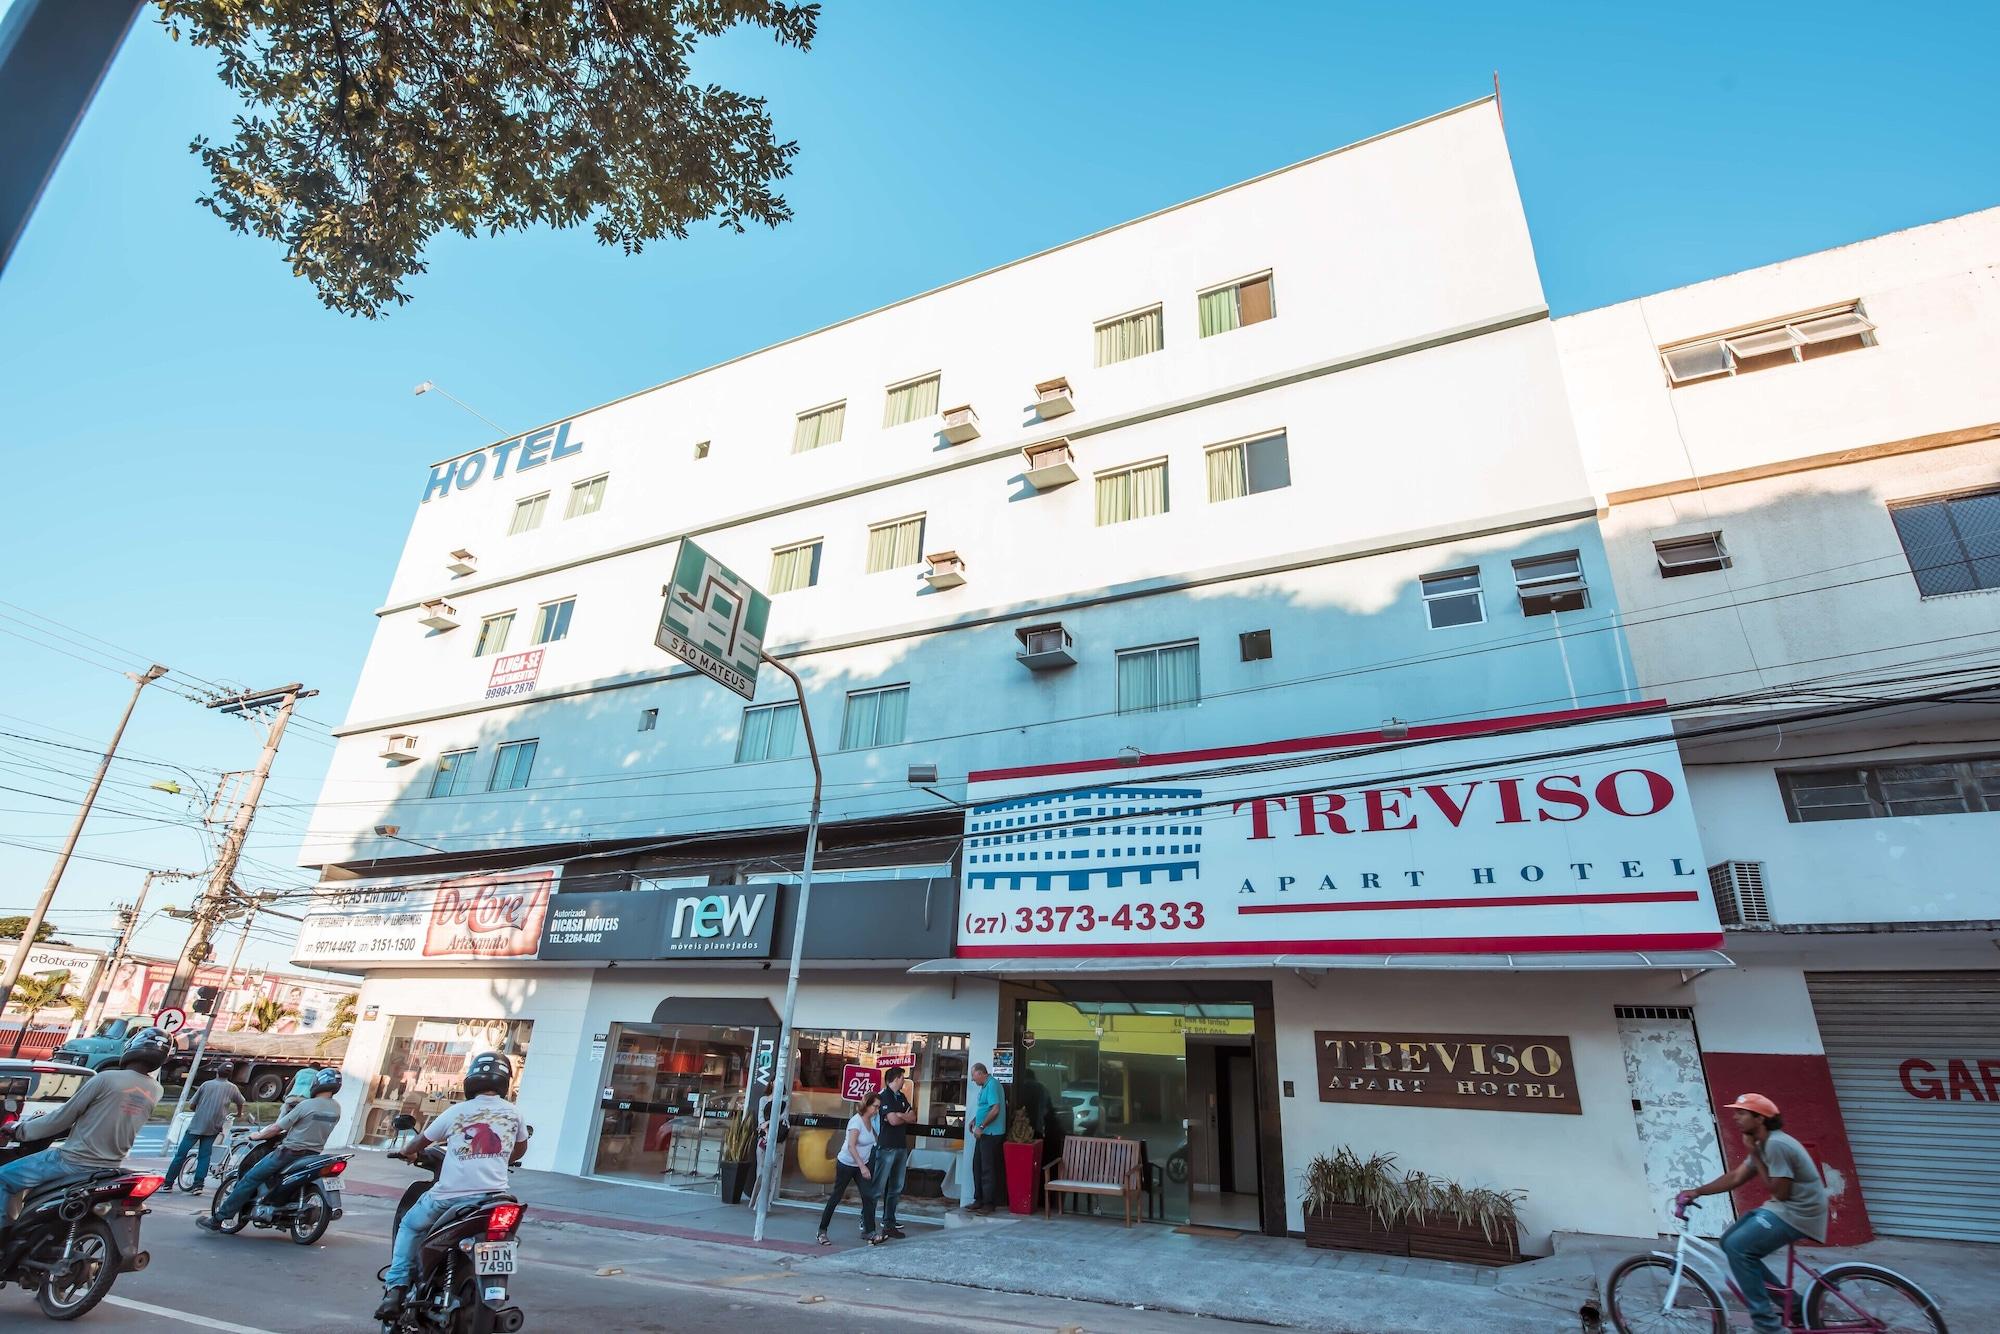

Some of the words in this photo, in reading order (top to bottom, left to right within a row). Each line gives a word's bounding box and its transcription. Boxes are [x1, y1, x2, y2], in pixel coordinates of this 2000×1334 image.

[421, 421, 583, 504] HOTEL
[671, 638, 696, 660] SÃO
[700, 655, 745, 690] MATEUS
[1233, 769, 1675, 840] TREVISO
[1239, 870, 1425, 894] APART
[1472, 858, 1696, 885] HOTEL
[551, 919, 583, 931] DICASA
[584, 915, 619, 931] MÓVEIS
[554, 909, 587, 918] Autorizada
[671, 893, 766, 938] new
[965, 912, 1007, 934] (27)
[1015, 902, 1206, 933] 3373-4333
[370, 938, 416, 951] 3151-1500
[564, 933, 602, 943] 3264-4012
[670, 940, 702, 950] móveis
[704, 940, 759, 952] planejados
[1324, 1040, 1562, 1077] TREVISO
[1328, 1075, 1426, 1094] APART
[1456, 1080, 1565, 1099] HOTEL
[480, 1262, 513, 1273] 7490
